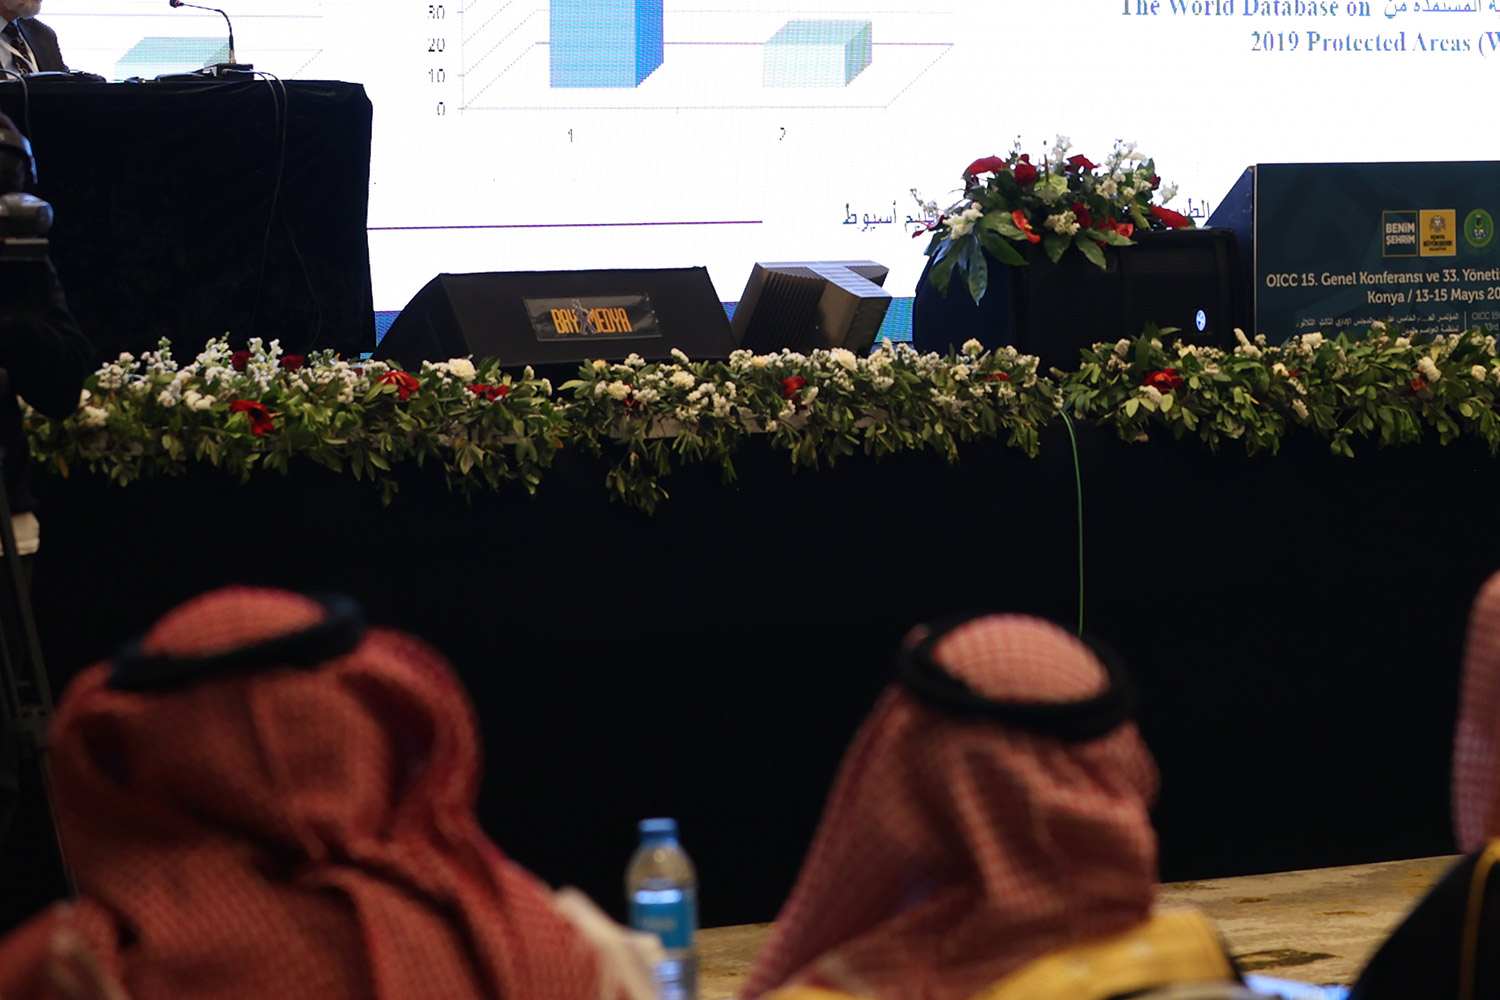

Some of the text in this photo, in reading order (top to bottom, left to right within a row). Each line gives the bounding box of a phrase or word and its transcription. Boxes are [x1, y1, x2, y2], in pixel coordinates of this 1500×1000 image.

[1347, 1, 1371, 16] on
[1251, 31, 1299, 51] 2019
[1306, 31, 1406, 51] Protected
[1413, 32, 1470, 51] Areas
[1266, 274, 1298, 287] OICC
[1301, 272, 1318, 286] 15.
[1321, 272, 1356, 286] Genel
[1359, 270, 1424, 284] Konferansı
[1426, 272, 1440, 282] ve
[1442, 268, 1460, 282] 33.
[1367, 290, 1405, 306] Konya
[1416, 288, 1448, 302] 13-15
[1451, 288, 1484, 304] Mayıs
